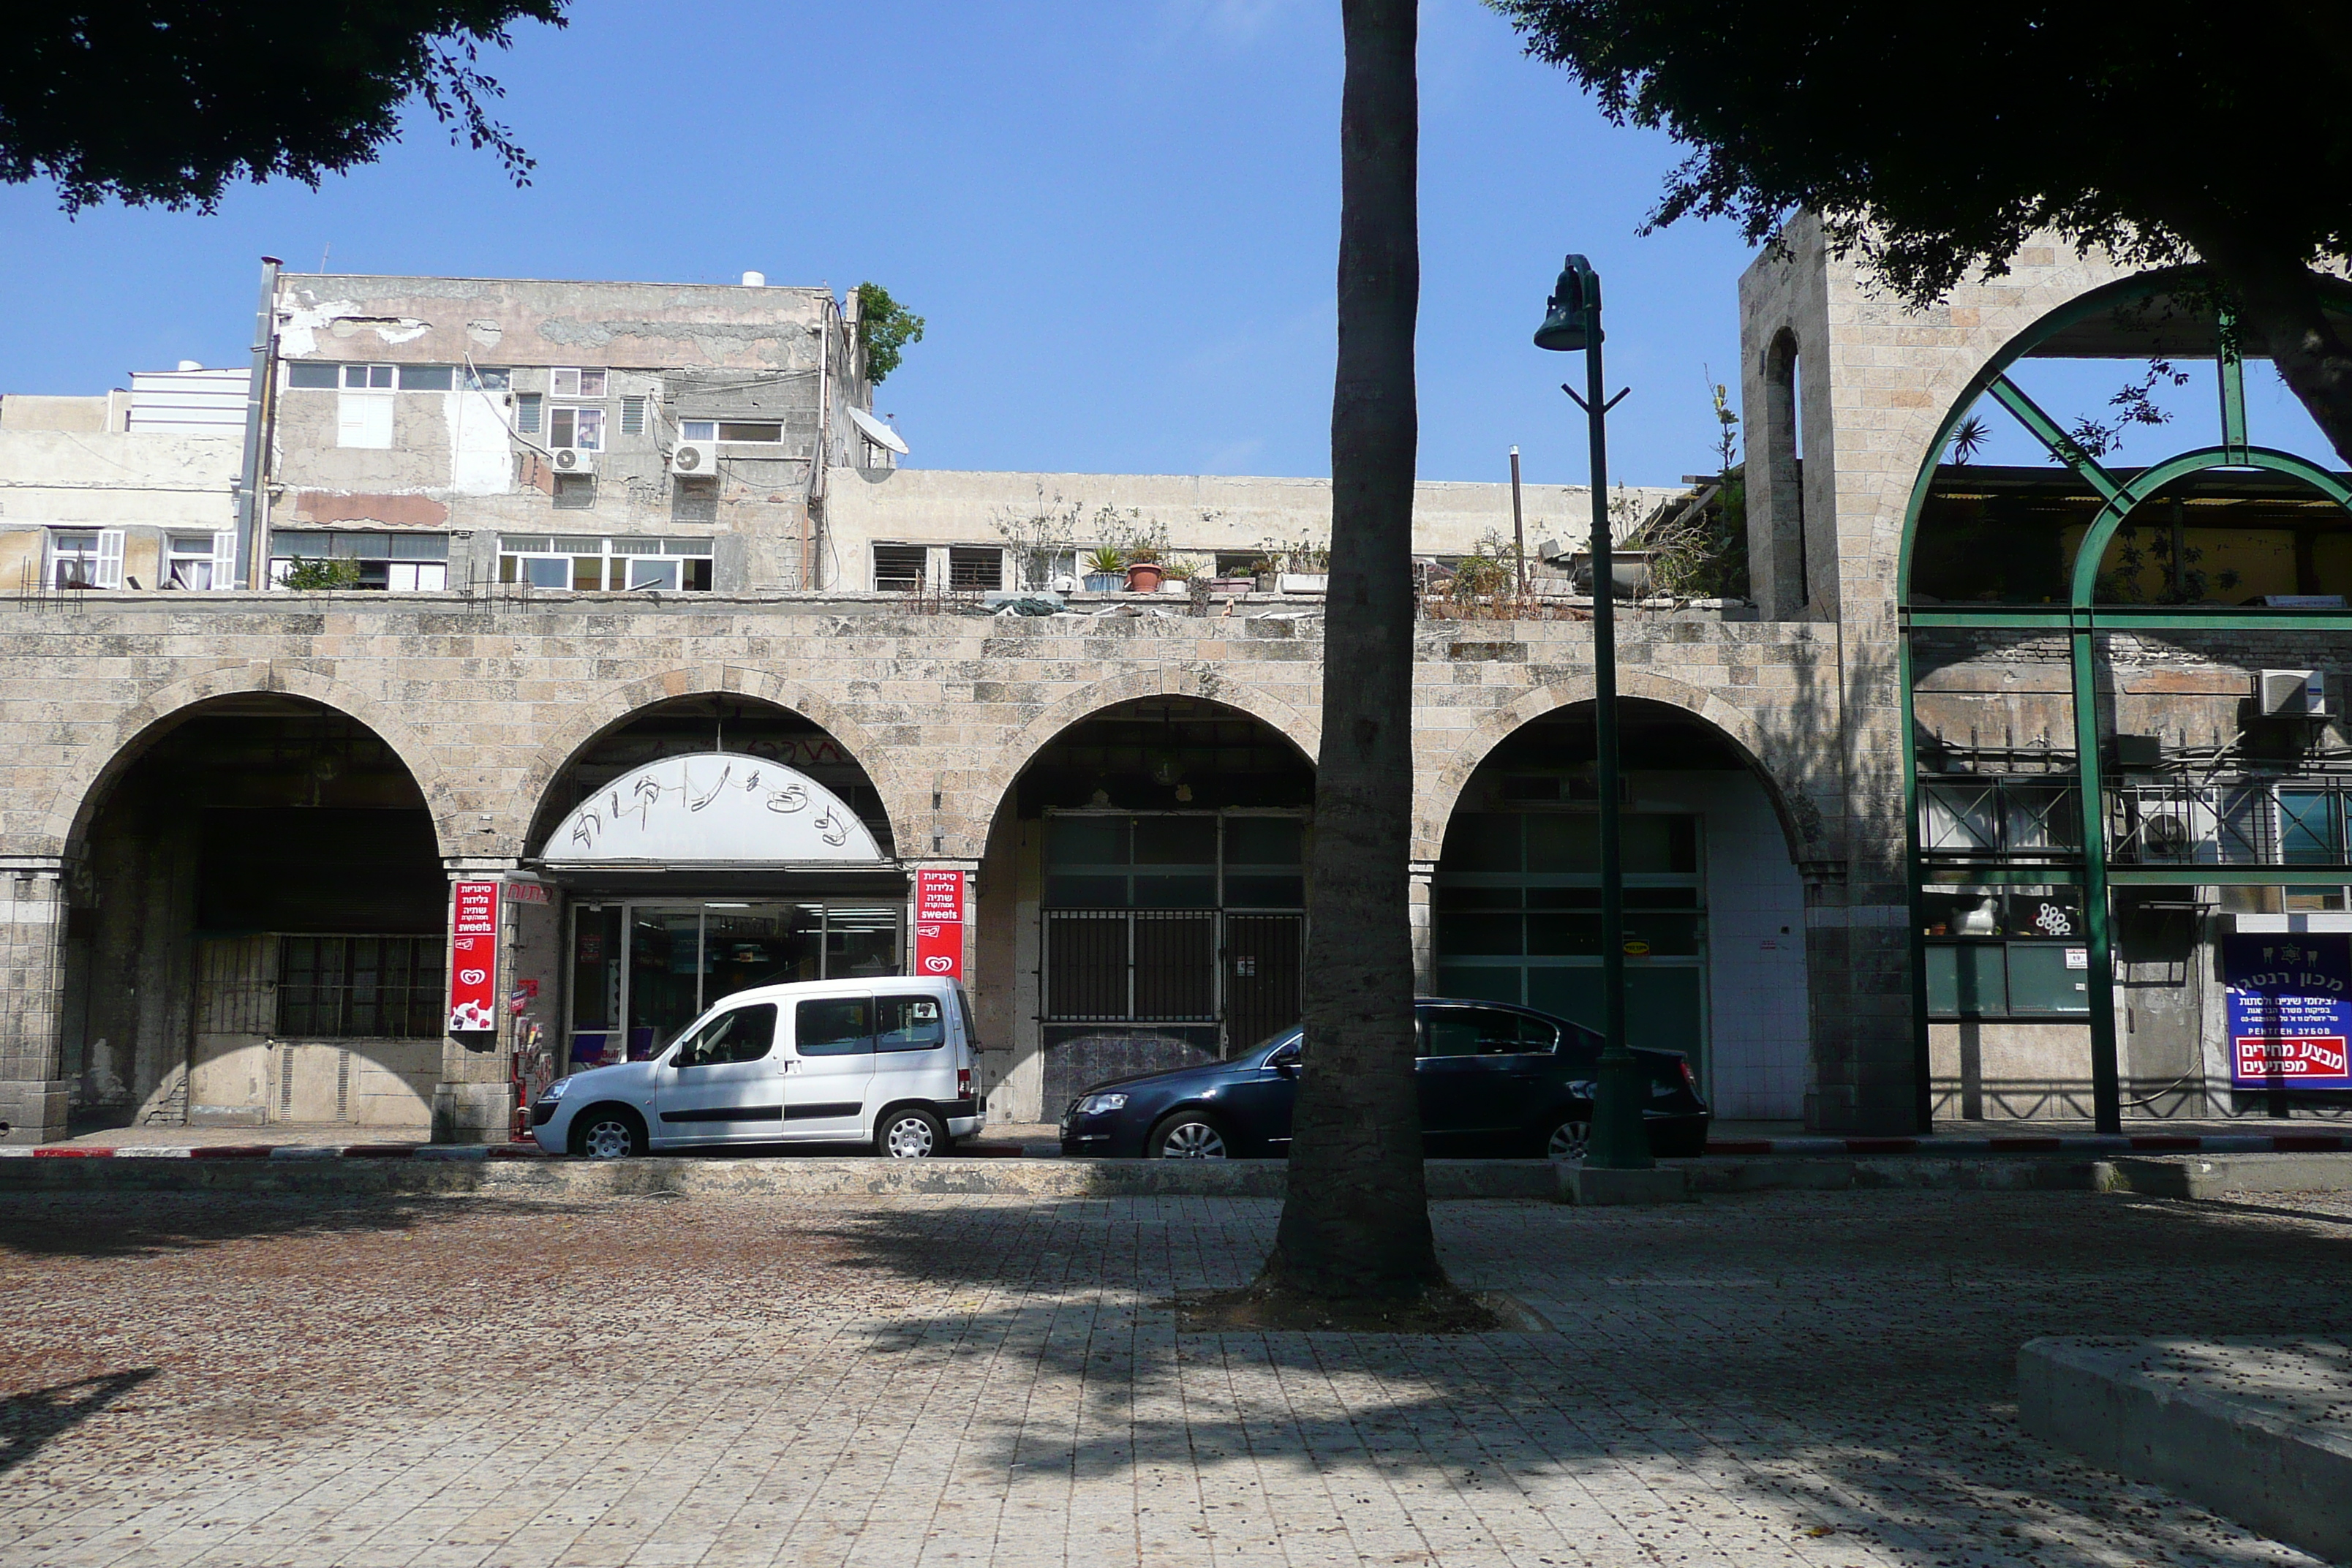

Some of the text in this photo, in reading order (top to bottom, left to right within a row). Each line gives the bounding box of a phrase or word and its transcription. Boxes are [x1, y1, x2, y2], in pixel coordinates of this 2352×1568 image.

[924, 872, 957, 881] סיגריות
[460, 885, 491, 894] סיגריות
[925, 882, 954, 892] גלידות
[507, 883, 554, 902] פתוח
[461, 894, 489, 905] גלידות
[921, 909, 957, 919] sweets
[459, 921, 491, 932] sweets
[2299, 971, 2344, 992] מכון
[2239, 996, 2337, 1006] לצילומי שיניים ולסתות
[2304, 1007, 2331, 1015] בפיקוח
[601, 1049, 619, 1058] Bull
[2242, 1041, 2343, 1070] מבצע מחירים
[2242, 1060, 2307, 1074] מפתיעים
